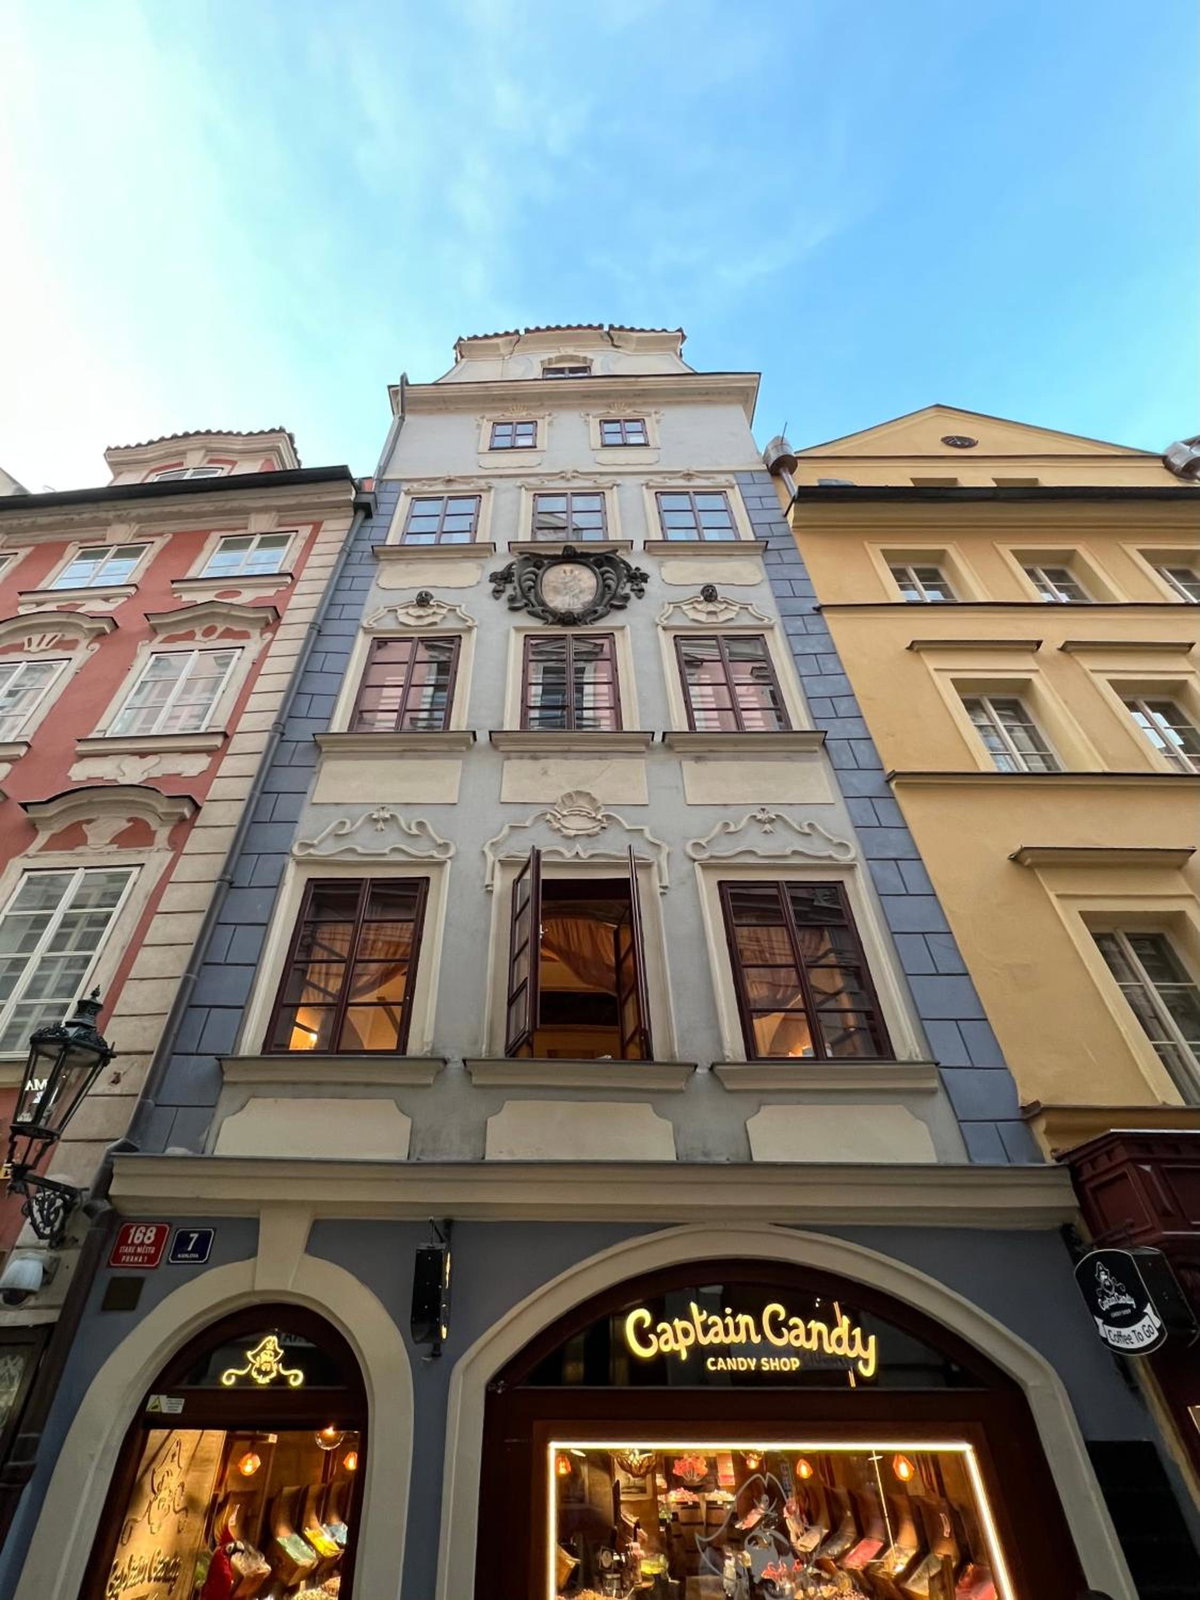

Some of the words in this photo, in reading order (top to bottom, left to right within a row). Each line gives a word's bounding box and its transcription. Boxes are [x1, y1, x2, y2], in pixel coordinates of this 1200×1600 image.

[127, 1226, 157, 1244] 168
[187, 1233, 199, 1251] 7
[121, 1255, 143, 1263] PRAHA
[625, 1301, 761, 1361] Captain
[762, 1303, 876, 1377] Candy
[1107, 1329, 1134, 1345] Coffee
[1131, 1329, 1144, 1342] To
[1141, 1324, 1155, 1338] Go
[706, 1357, 757, 1371] CANDY
[761, 1357, 800, 1371] SHOP
